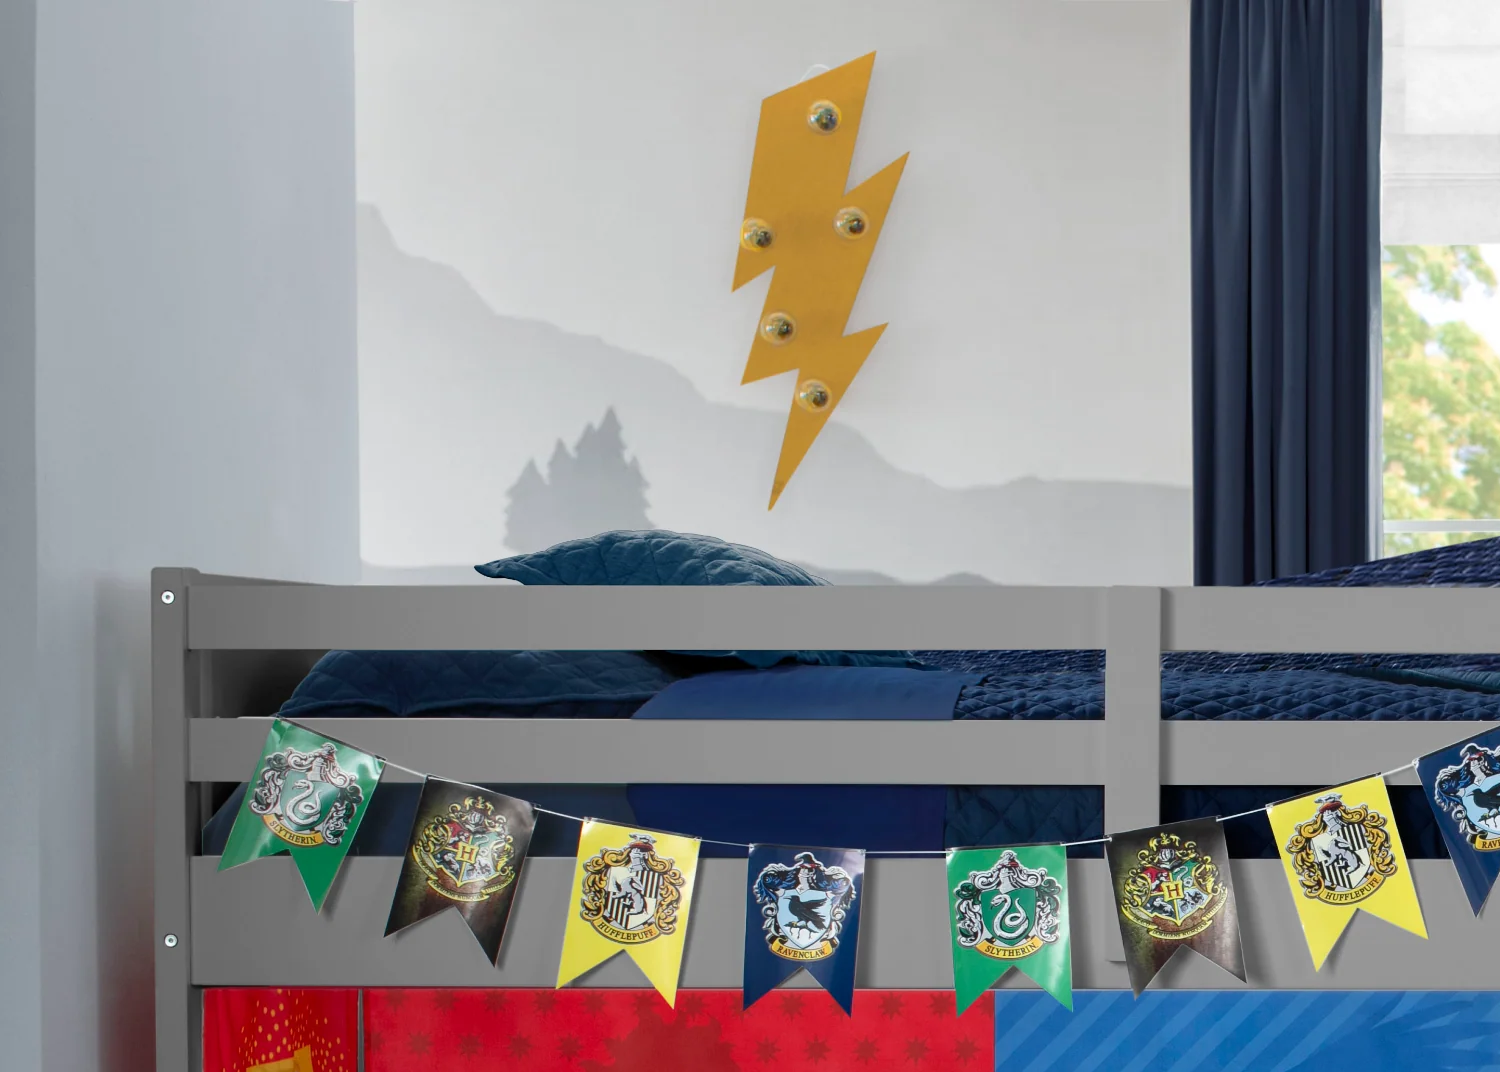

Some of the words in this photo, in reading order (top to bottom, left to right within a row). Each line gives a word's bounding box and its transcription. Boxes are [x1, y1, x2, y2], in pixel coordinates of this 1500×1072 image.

[269, 820, 319, 845] SLYTHERIN
[461, 845, 476, 862] H
[1165, 883, 1181, 899] H
[1325, 877, 1380, 901] HUFFLEPUFF
[597, 921, 655, 941] HUFFLEPUFF
[777, 945, 827, 959] RAVENCLAW
[984, 942, 1037, 957] SLYTHERIN
